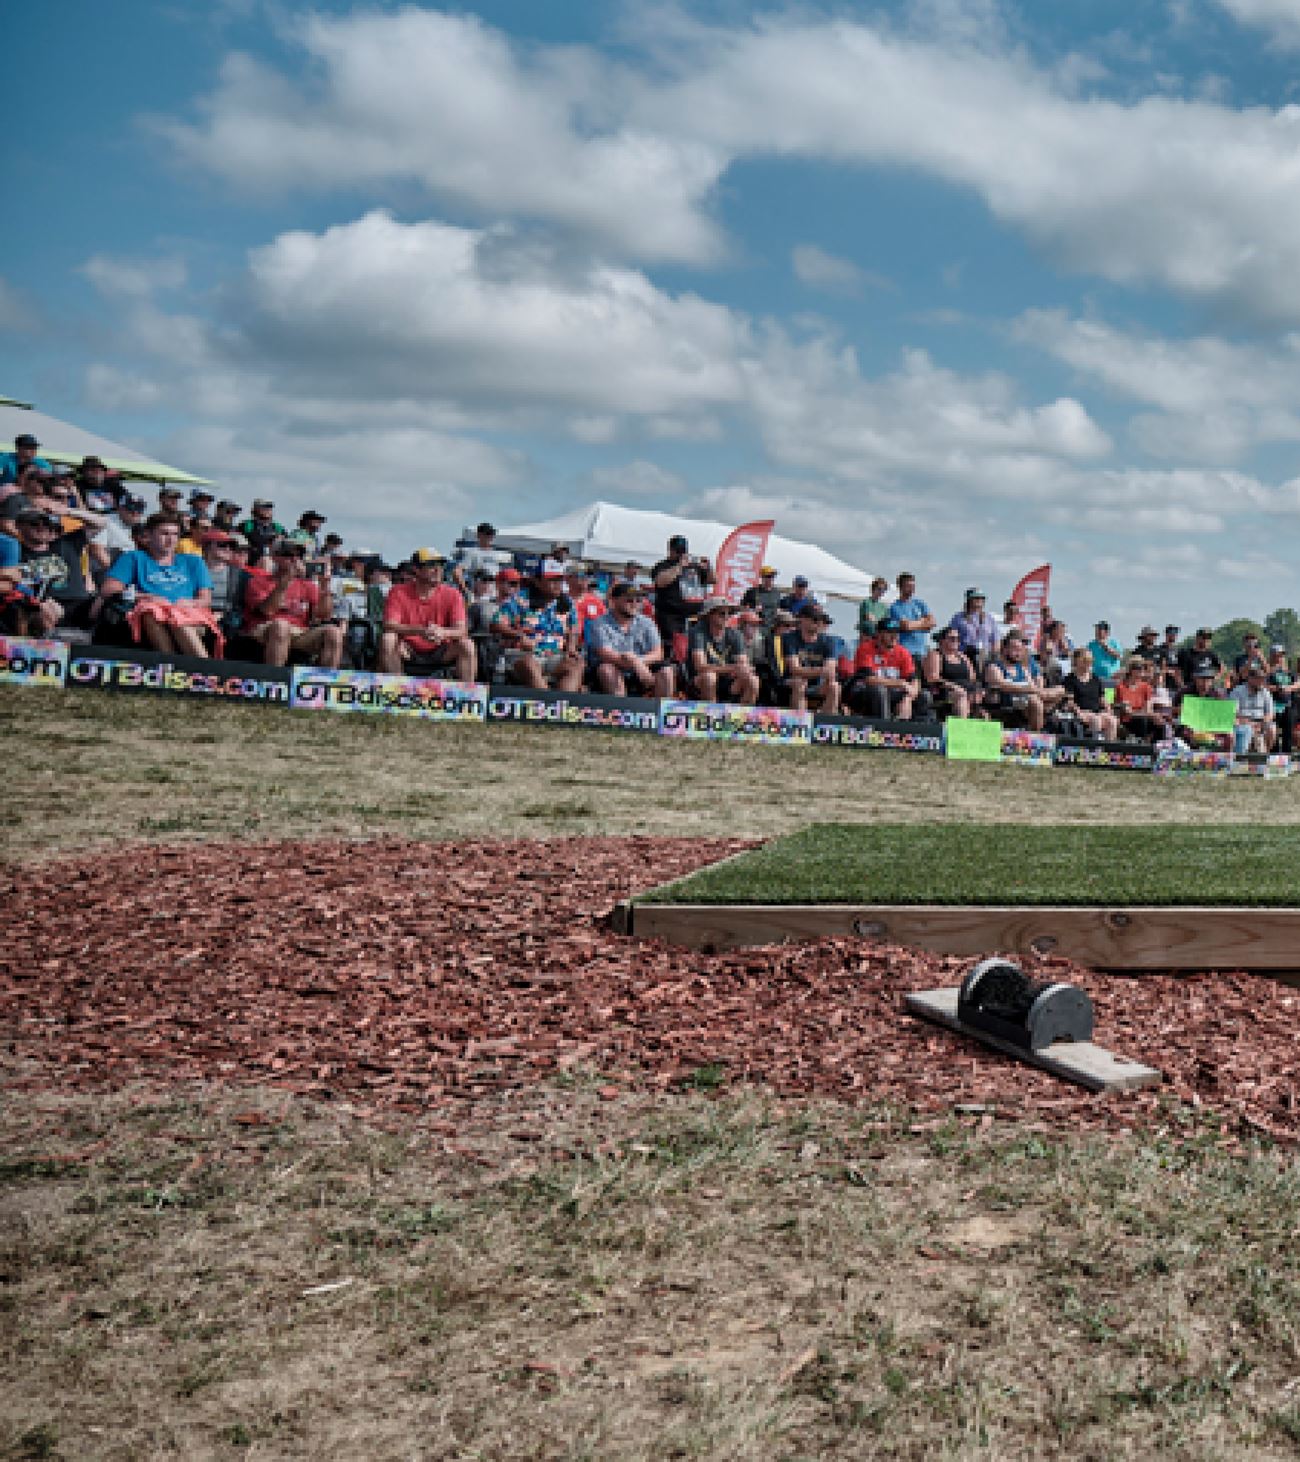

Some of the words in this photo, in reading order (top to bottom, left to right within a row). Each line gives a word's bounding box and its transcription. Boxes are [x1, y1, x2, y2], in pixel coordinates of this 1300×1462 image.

[69, 656, 289, 701] OTBdiscs.com
[296, 682, 483, 715] OTBdiscs.com
[489, 697, 657, 729] OTBdiscs.com
